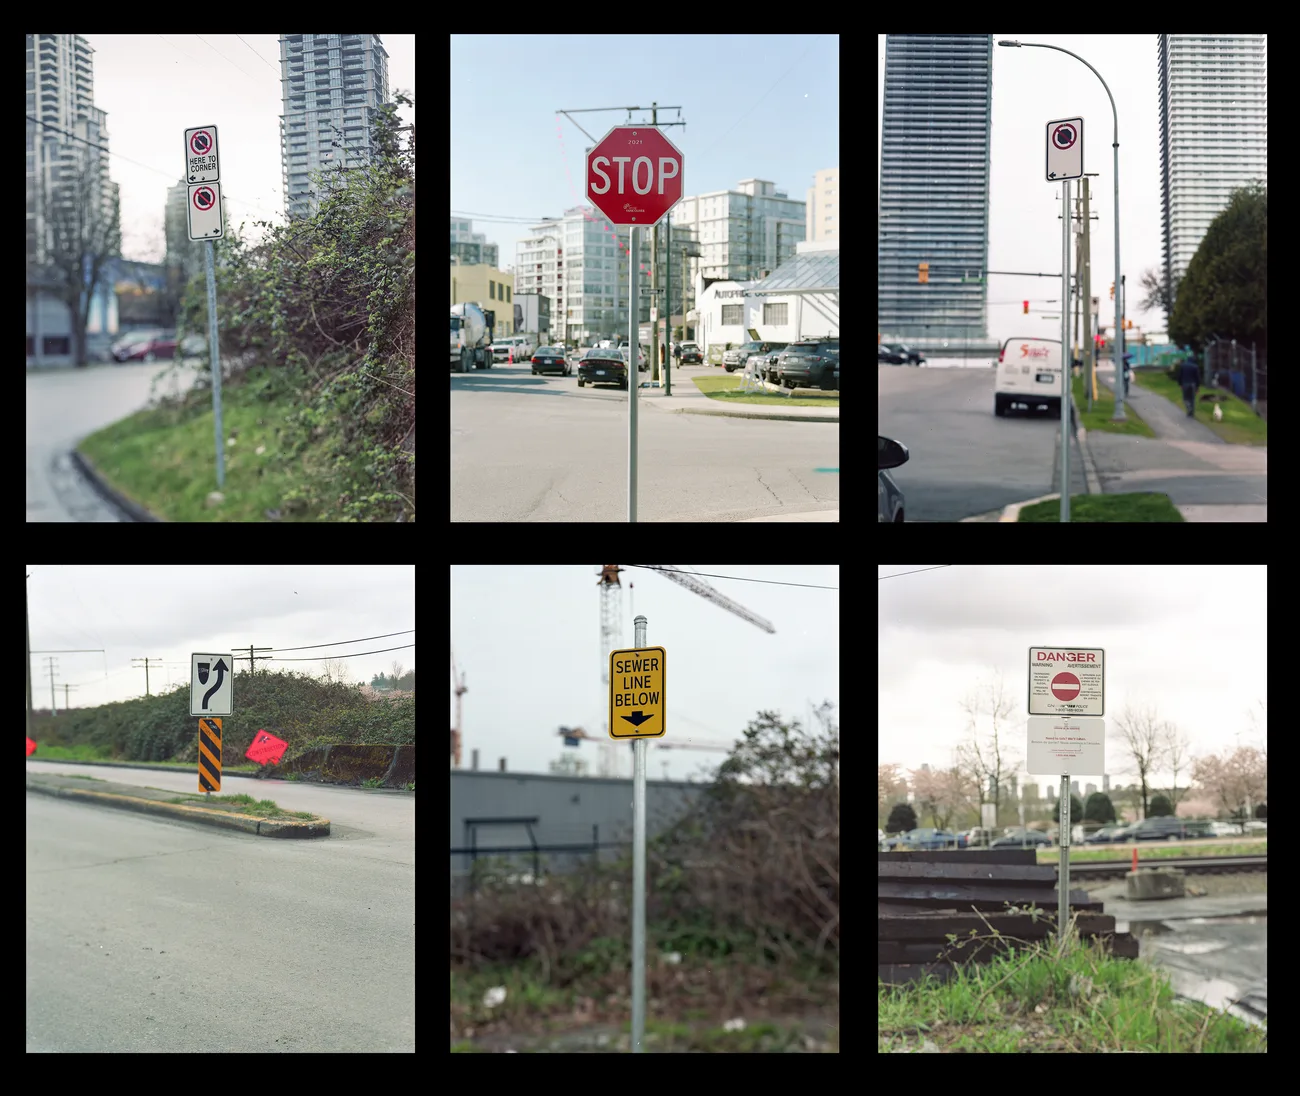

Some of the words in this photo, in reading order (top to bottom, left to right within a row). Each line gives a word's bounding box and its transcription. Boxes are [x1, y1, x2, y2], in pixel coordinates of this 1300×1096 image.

[190, 156, 206, 165] HERE
[208, 154, 217, 163] TO
[190, 163, 217, 173] CORNER
[590, 155, 679, 195] STOP
[1037, 651, 1096, 663] DANGER
[615, 658, 659, 674] SEWER
[623, 675, 652, 690] LINE
[615, 691, 660, 707] BELOW
